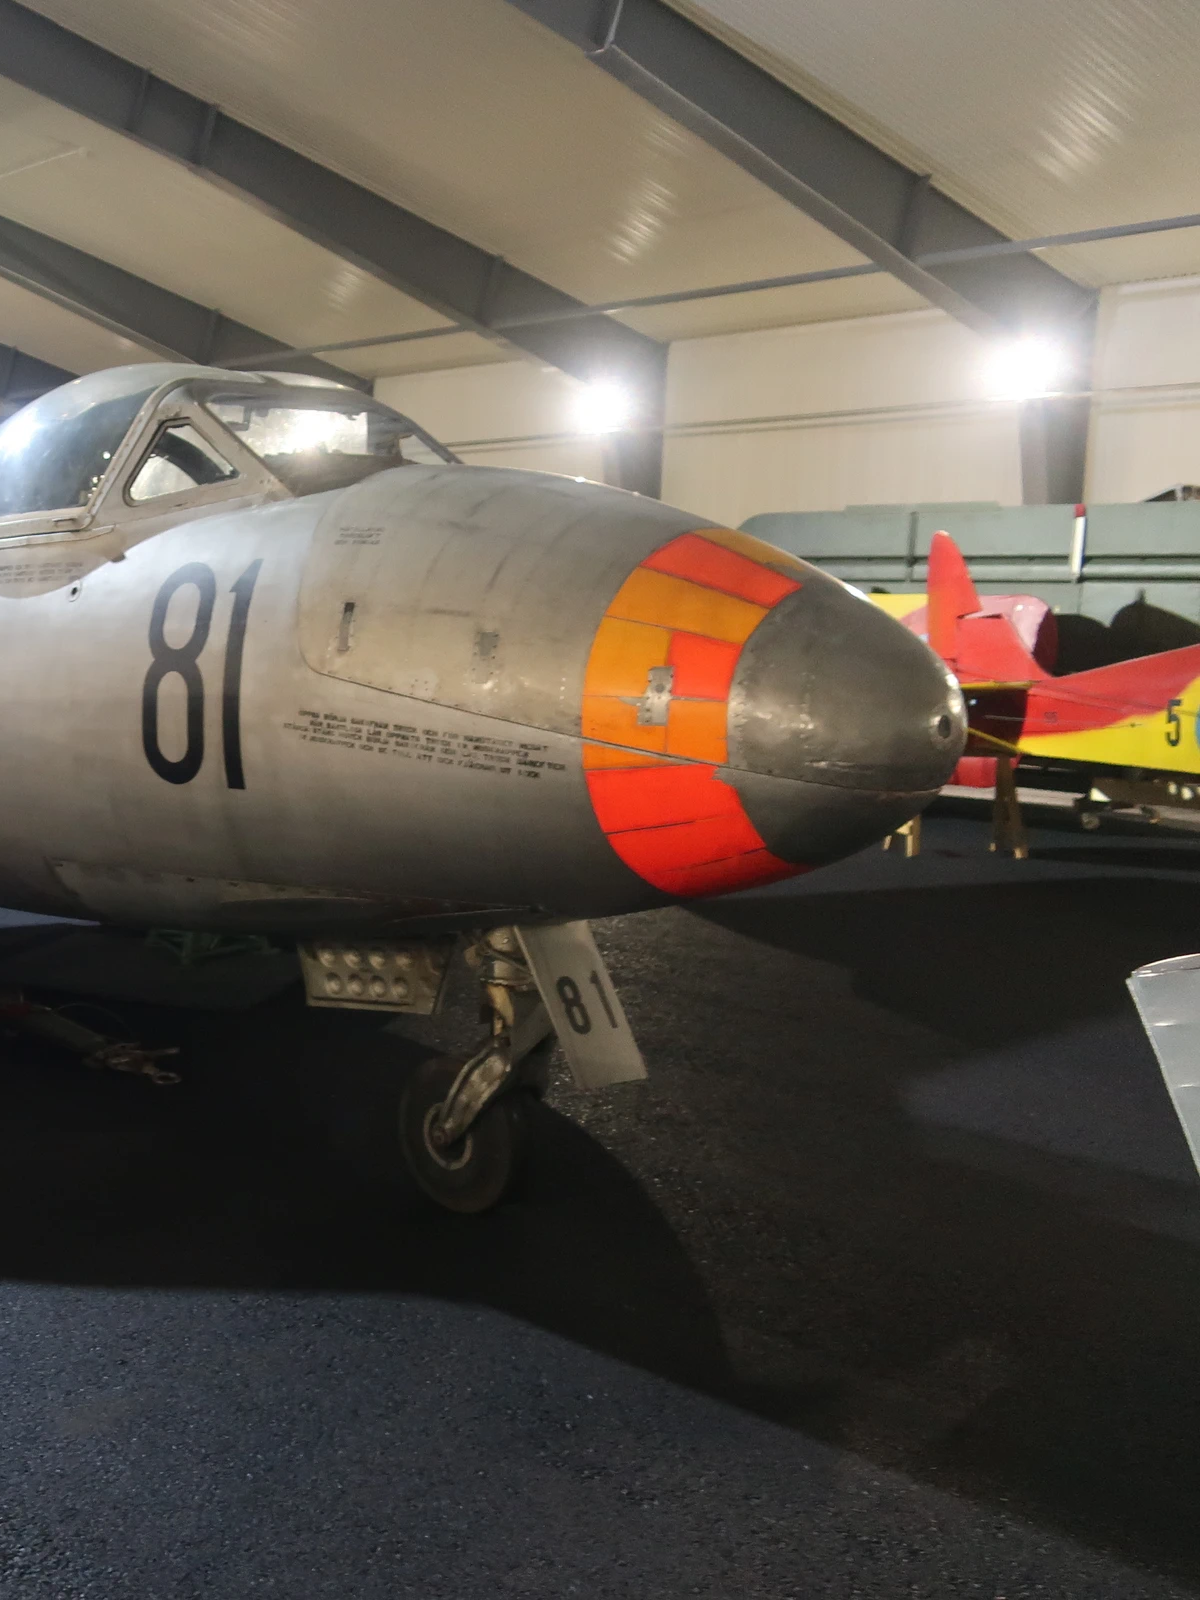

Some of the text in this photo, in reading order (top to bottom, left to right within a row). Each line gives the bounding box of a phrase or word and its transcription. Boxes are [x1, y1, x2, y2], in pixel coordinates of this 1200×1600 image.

[142, 558, 264, 790] 81
[1165, 699, 1183, 746] 5
[556, 970, 619, 1035] 81
